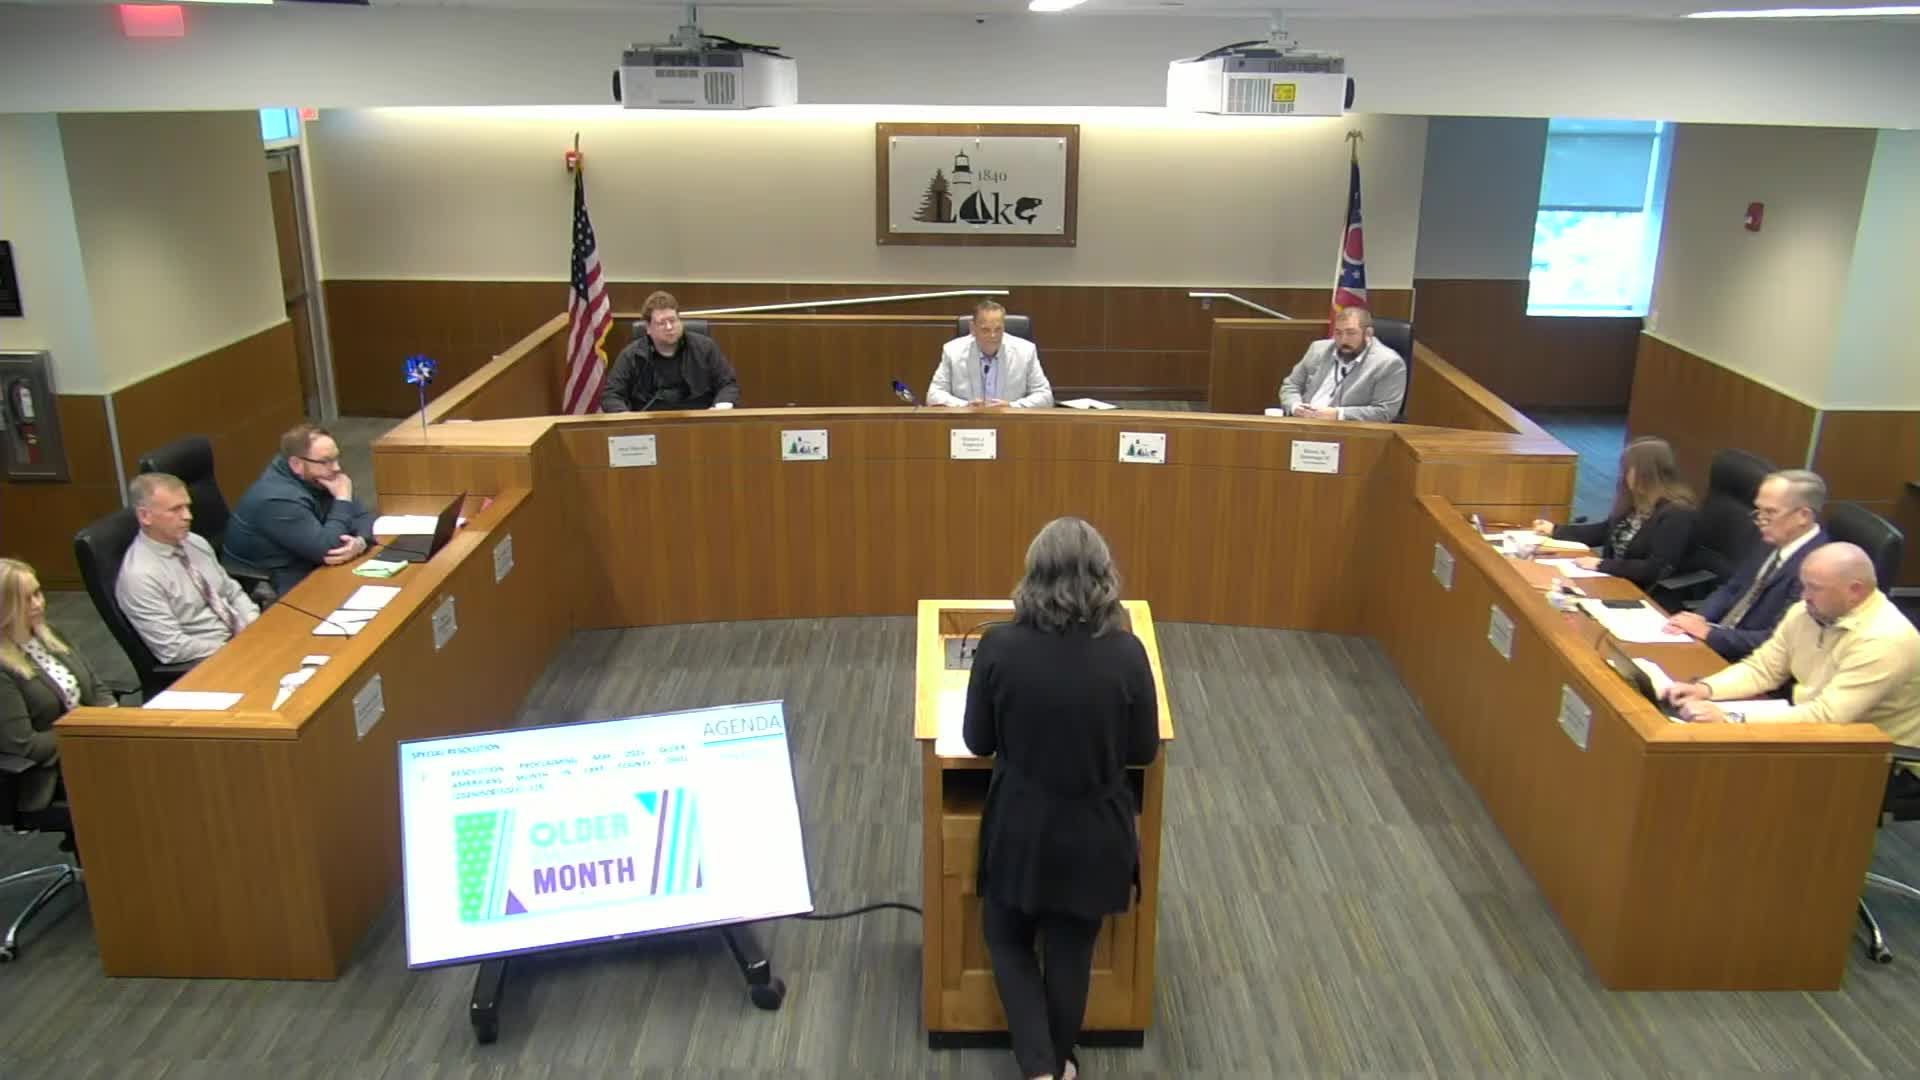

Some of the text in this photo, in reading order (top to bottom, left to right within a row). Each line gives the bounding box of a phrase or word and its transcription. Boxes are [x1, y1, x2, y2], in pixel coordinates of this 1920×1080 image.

[977, 169, 1008, 182] 1840
[703, 715, 782, 737] AGENDA
[529, 813, 630, 847] OLDER
[533, 856, 635, 895] MONTH
